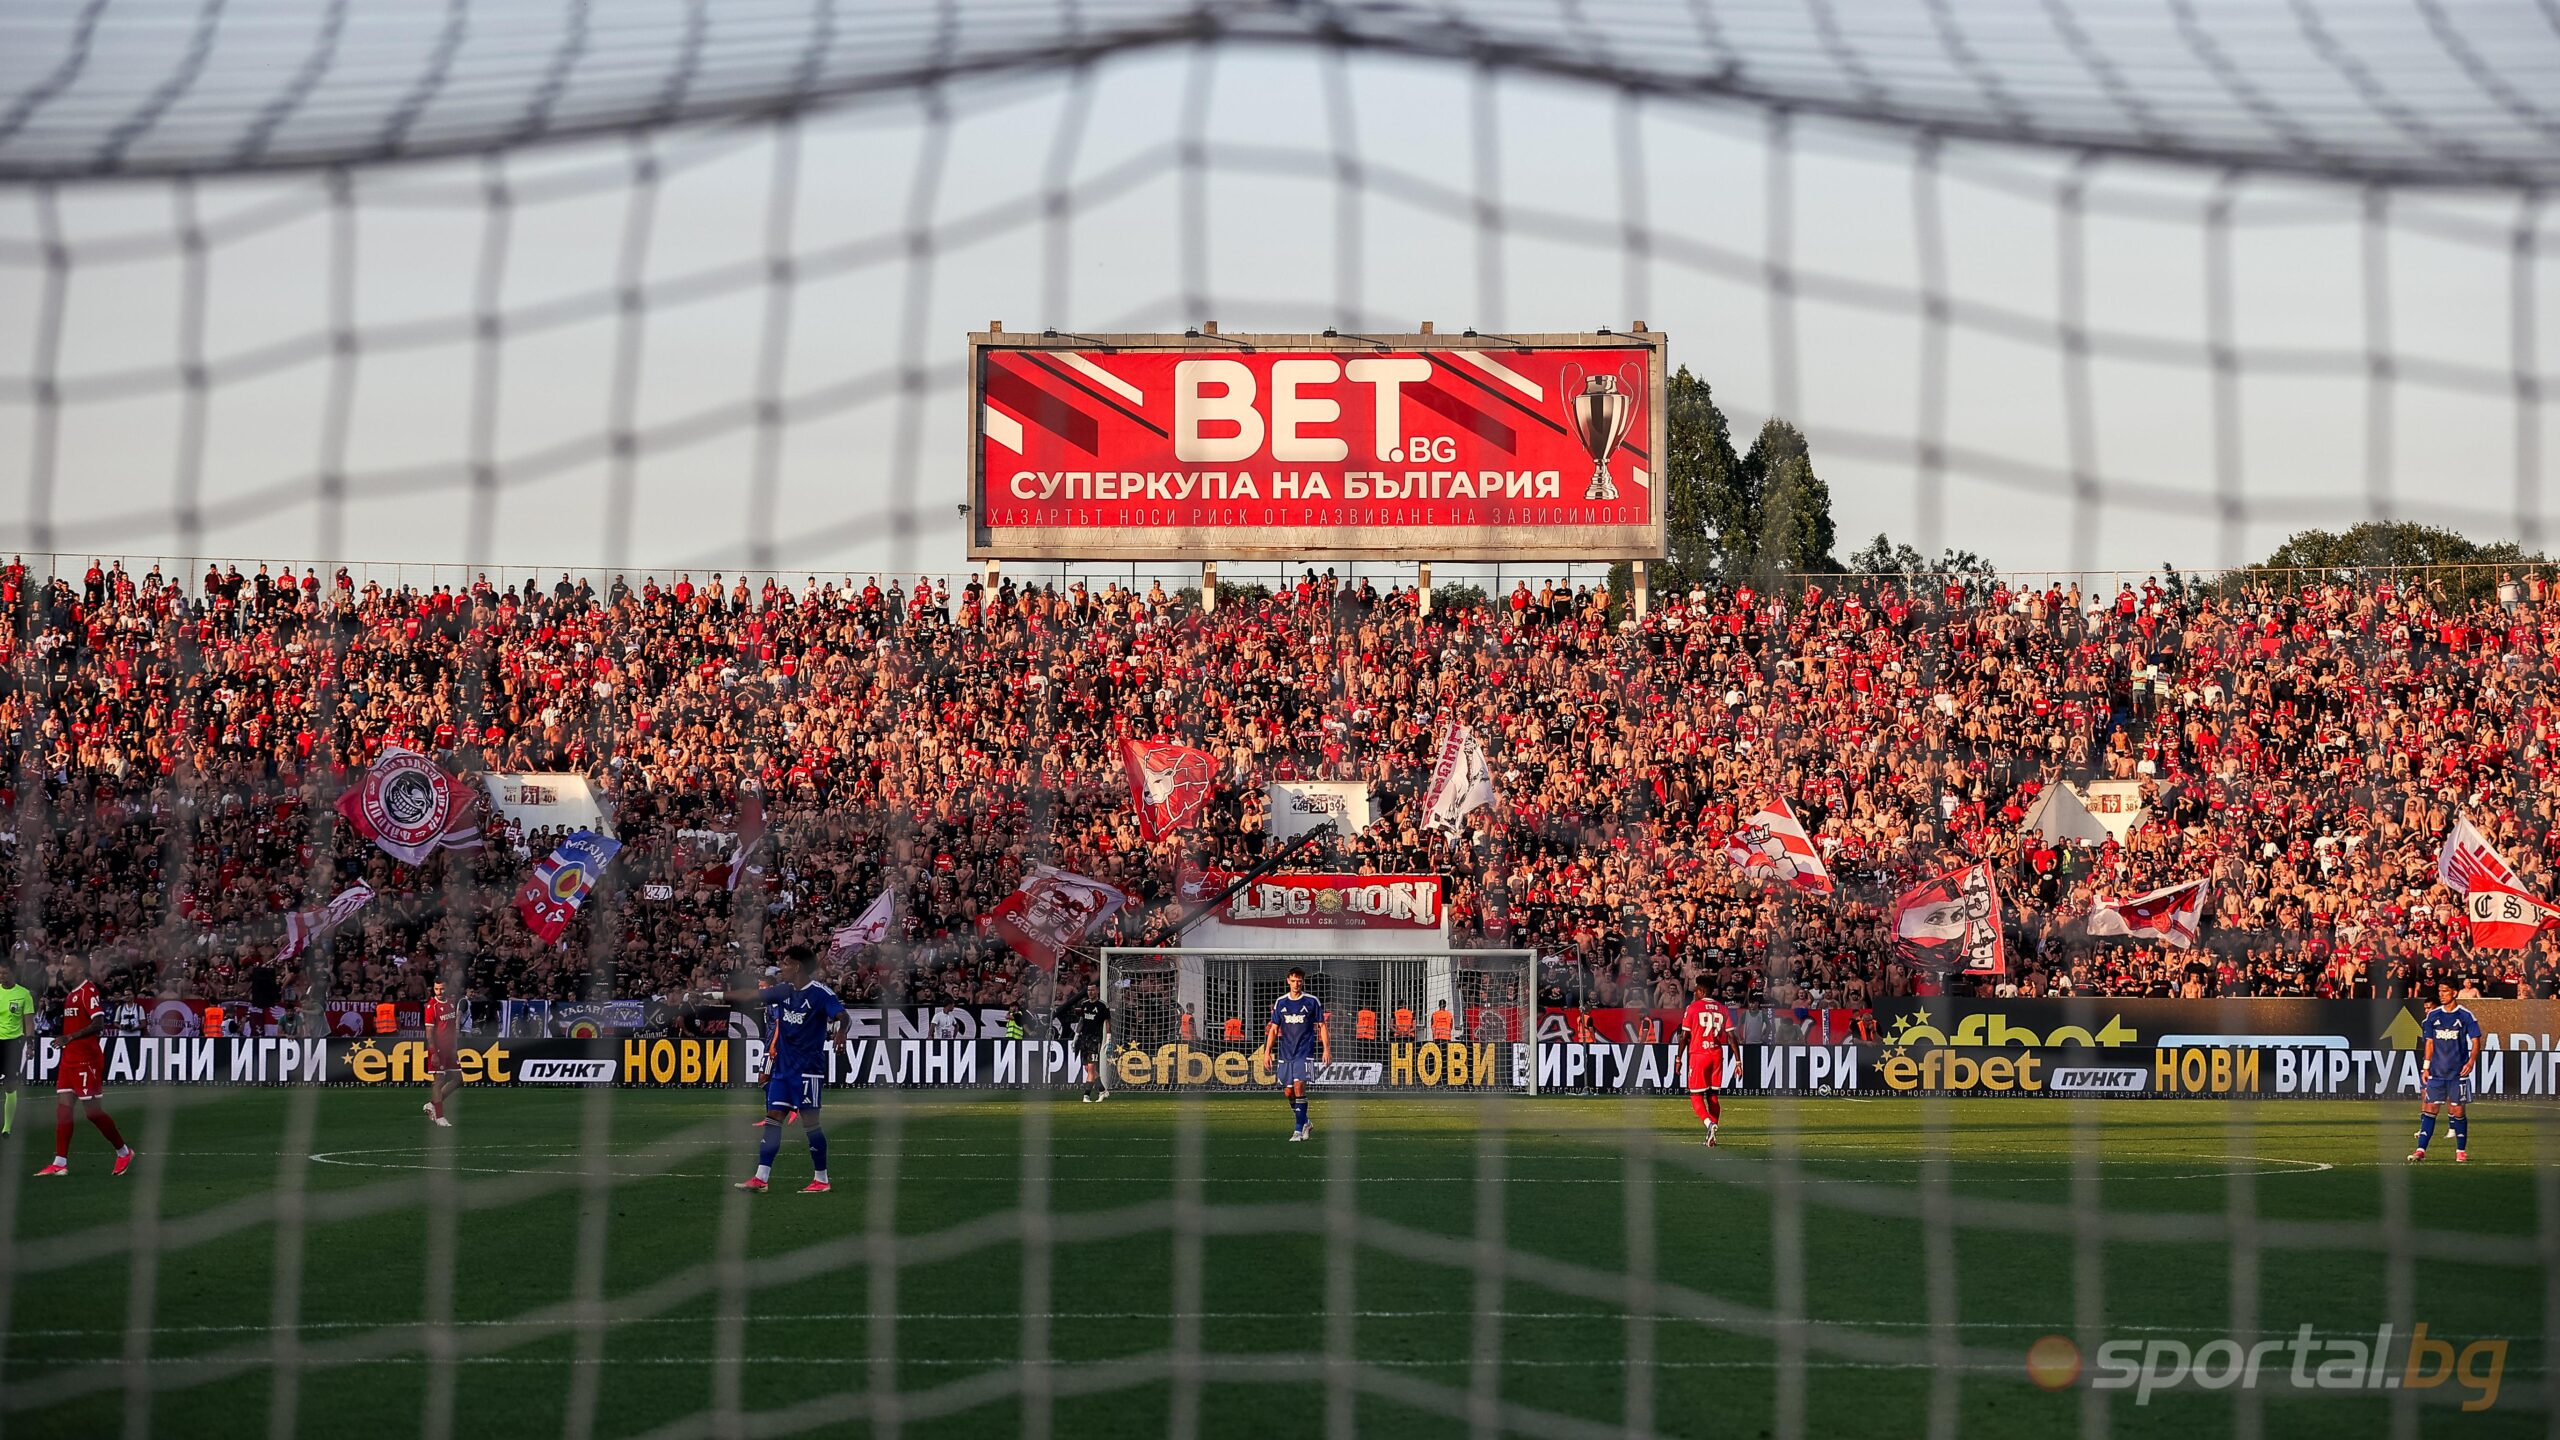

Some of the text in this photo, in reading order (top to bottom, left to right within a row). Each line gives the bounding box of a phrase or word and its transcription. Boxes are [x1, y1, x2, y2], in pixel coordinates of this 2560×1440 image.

[1010, 471, 1560, 500] СУПЕРКУПА НА БЪЛГАРИЯ
[990, 507, 1641, 525] ХАЗАРТЪТ НОСИ РИСК ОТ РАЗВИВАНЕ НА ЗАВИСИМОСТ
[525, 792, 537, 804] 21
[2104, 801, 2117, 812] 19
[1287, 917, 1367, 926] ULTRA CSKA SOFIA
[325, 1001, 378, 1013] YOUTHS
[231, 1037, 327, 1082] ИГРИ
[624, 1039, 729, 1083] НОВИ
[1390, 1042, 1496, 1086] НОВИ
[1761, 1044, 1857, 1089] ИГРИ
[529, 1063, 605, 1078] ПУНКТ
[1884, 1048, 2042, 1091] efbet
[2155, 1049, 2260, 1093] НОВИ
[79, 1072, 88, 1087] 7
[2062, 1071, 2138, 1087] ПУНКТ
[802, 1080, 809, 1095] 7
